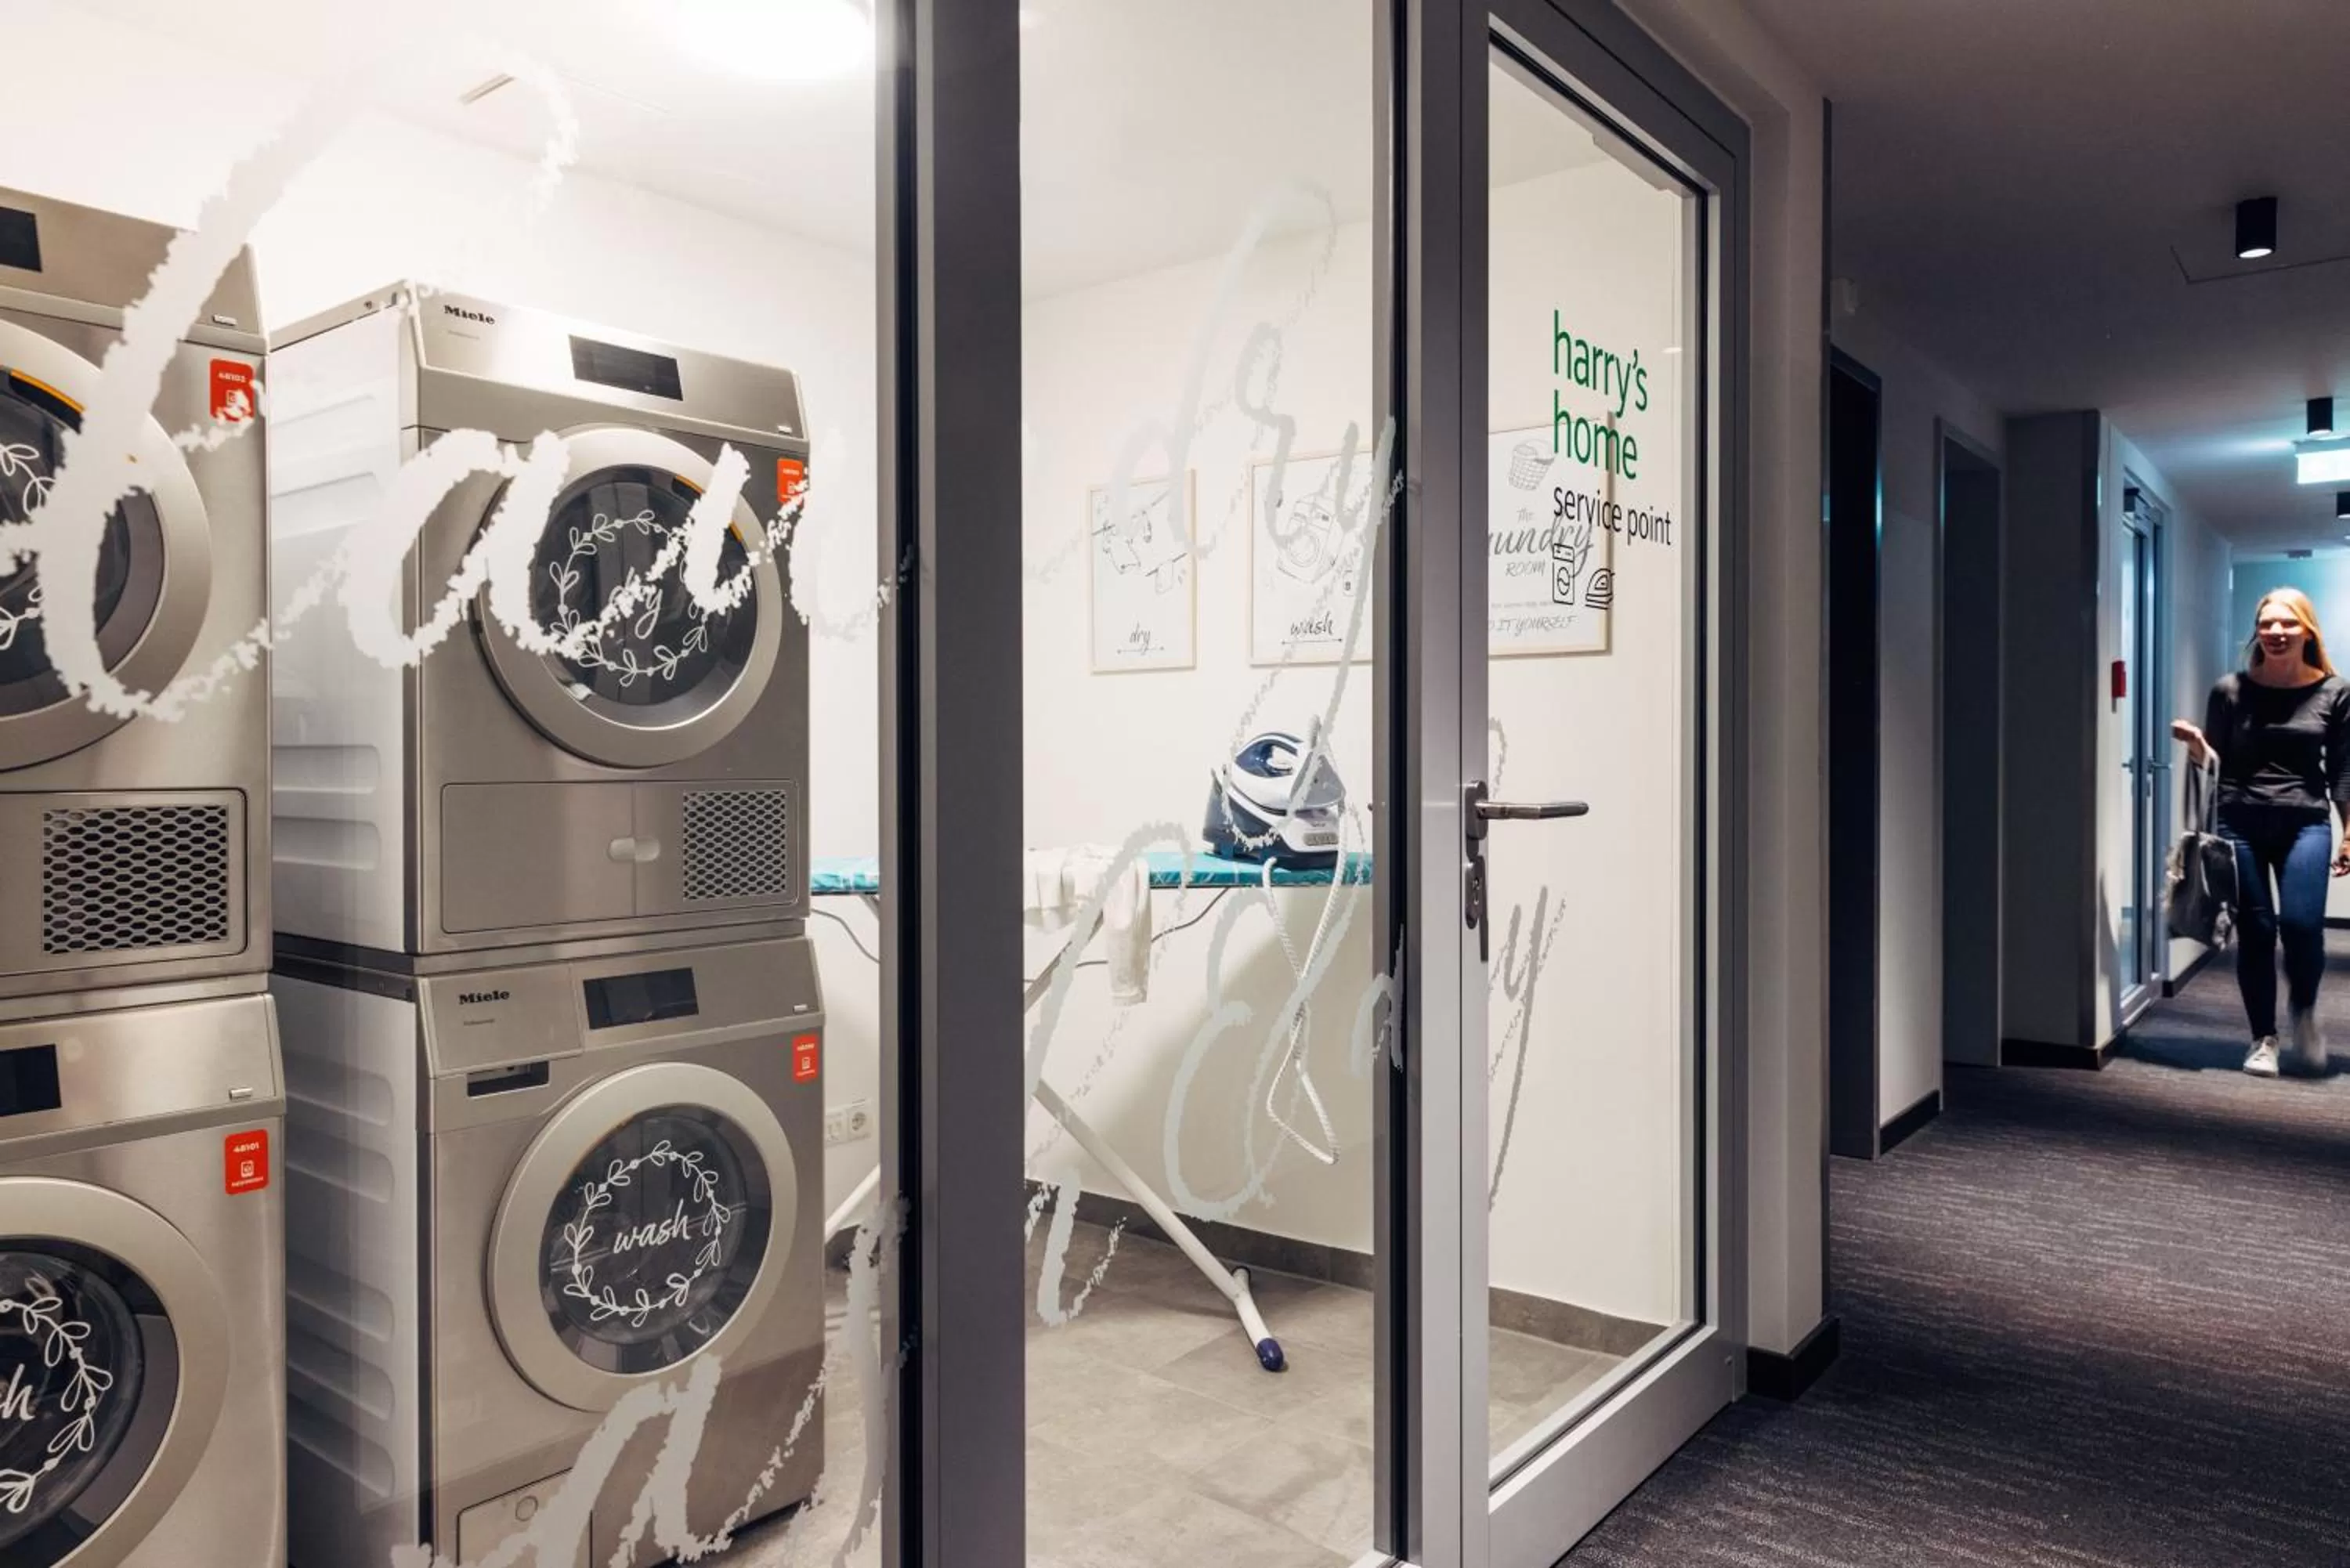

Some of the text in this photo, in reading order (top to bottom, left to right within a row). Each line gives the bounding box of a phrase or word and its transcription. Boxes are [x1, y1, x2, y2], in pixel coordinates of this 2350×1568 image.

[443, 305, 495, 325] Miele
[1553, 309, 1647, 418] harry's
[1553, 389, 1637, 479] home
[1553, 486, 1672, 546] service point
[1488, 514, 1594, 578] undry
[1129, 621, 1152, 656] dry
[1290, 611, 1334, 637] wash
[458, 989, 511, 1006] Miele
[613, 1198, 692, 1254] wash
